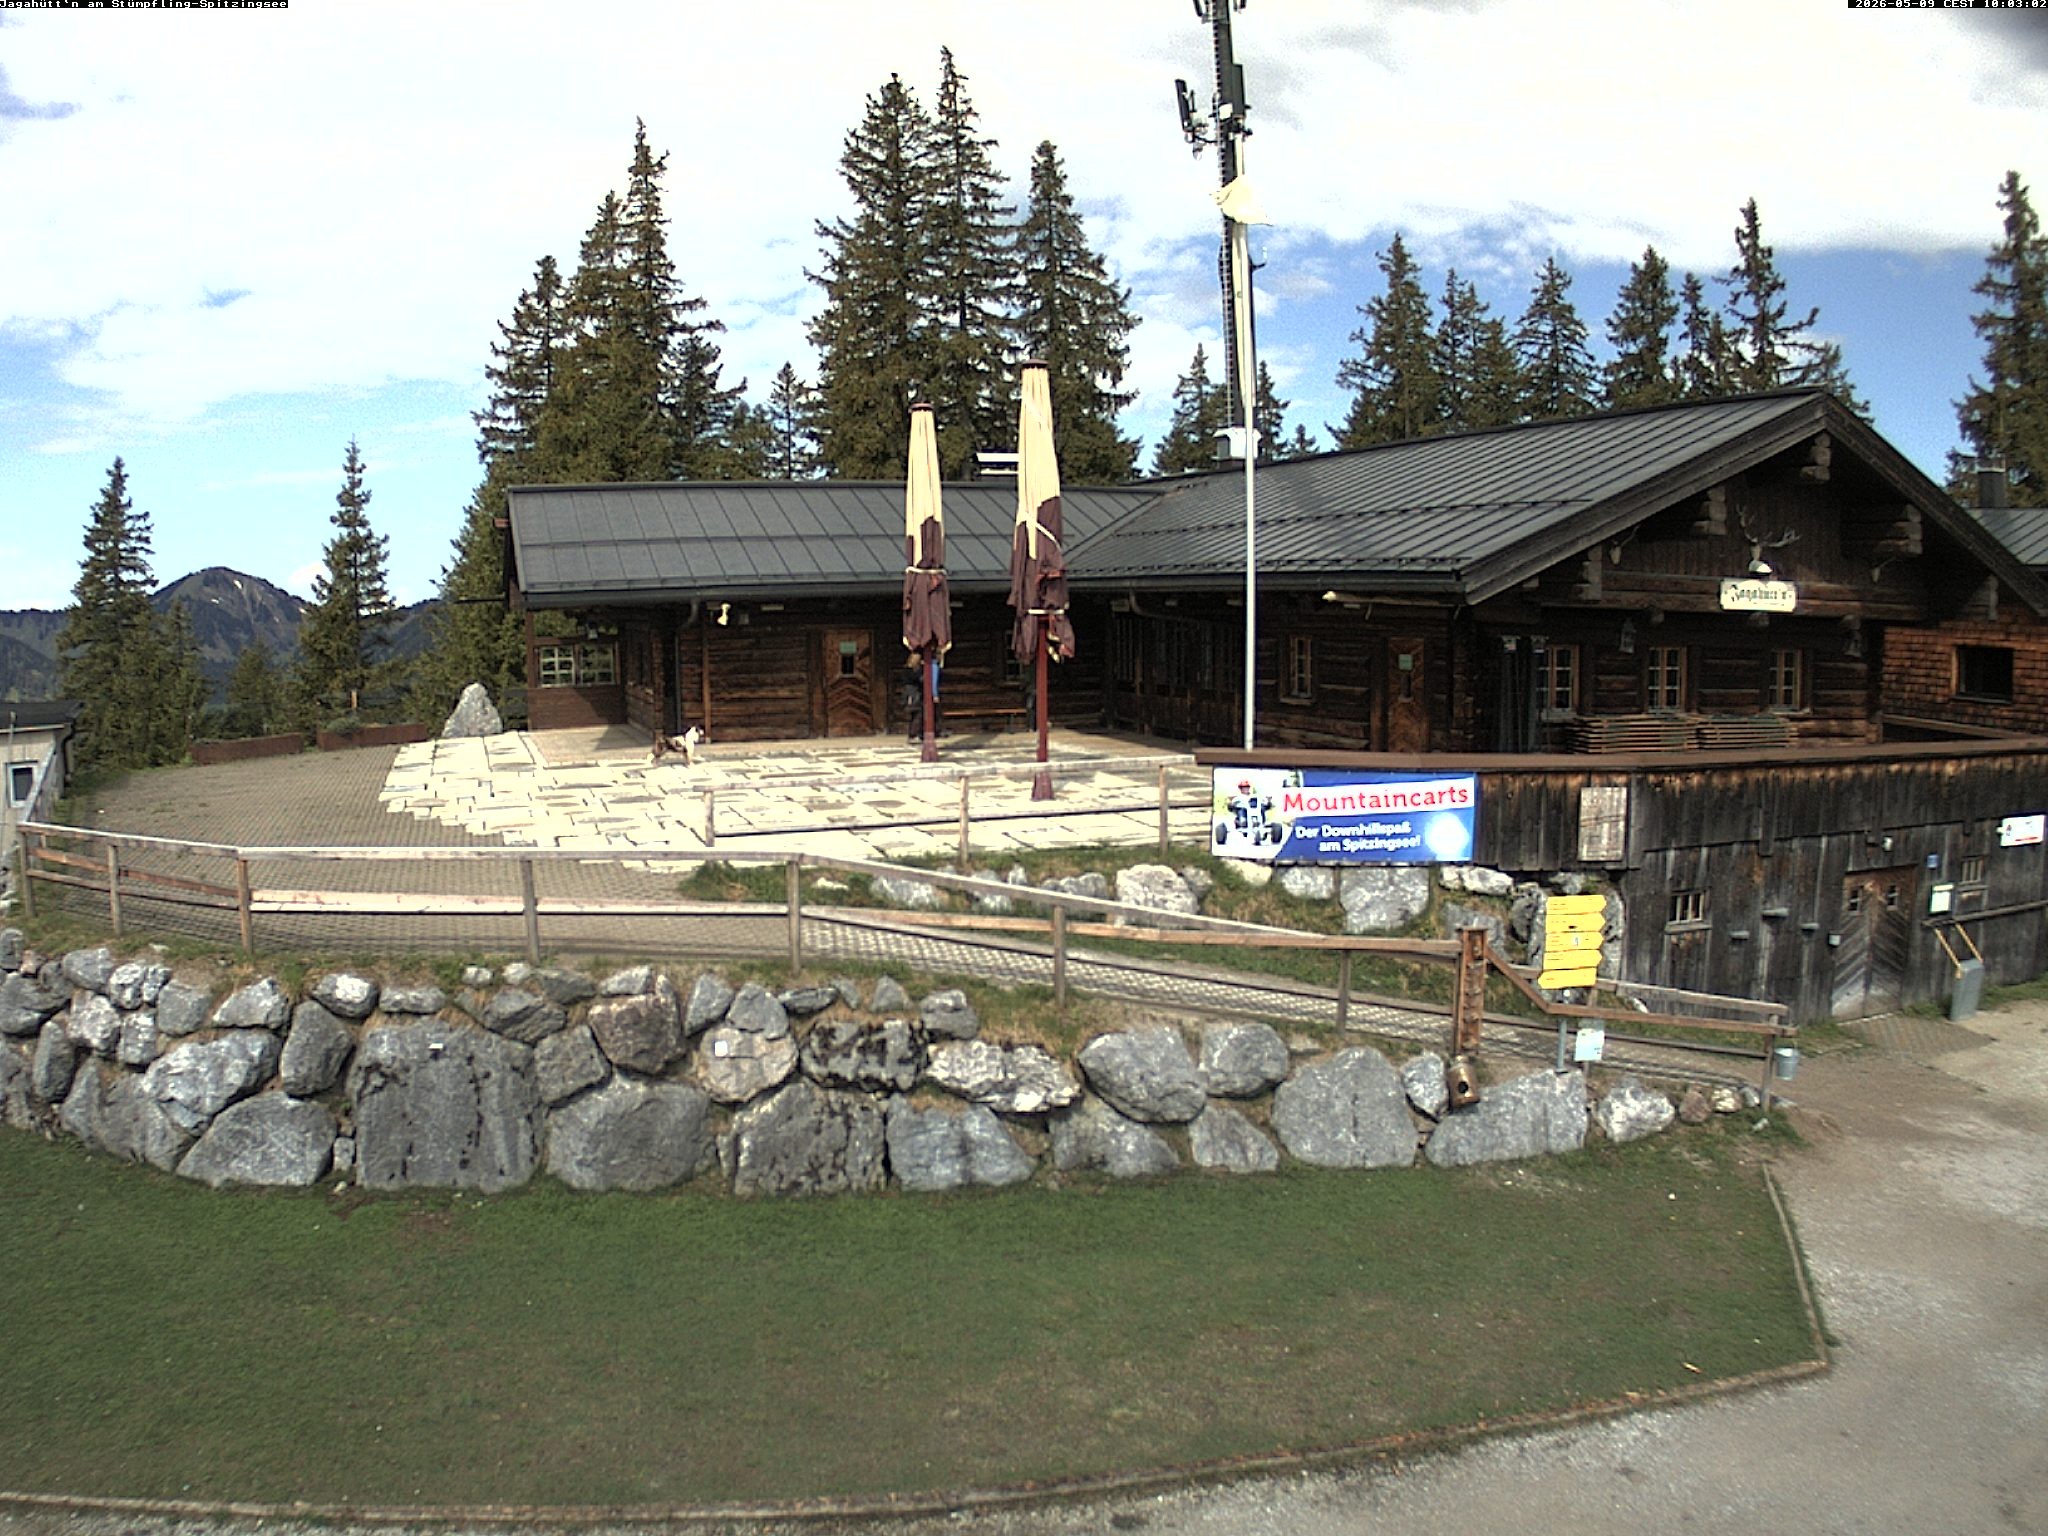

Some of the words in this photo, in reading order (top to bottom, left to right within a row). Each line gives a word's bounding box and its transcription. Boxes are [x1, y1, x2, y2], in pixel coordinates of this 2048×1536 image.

[1283, 786, 1470, 813] Mountaincarts
[1295, 825, 1319, 839] Der
[1319, 841, 1341, 852] am
